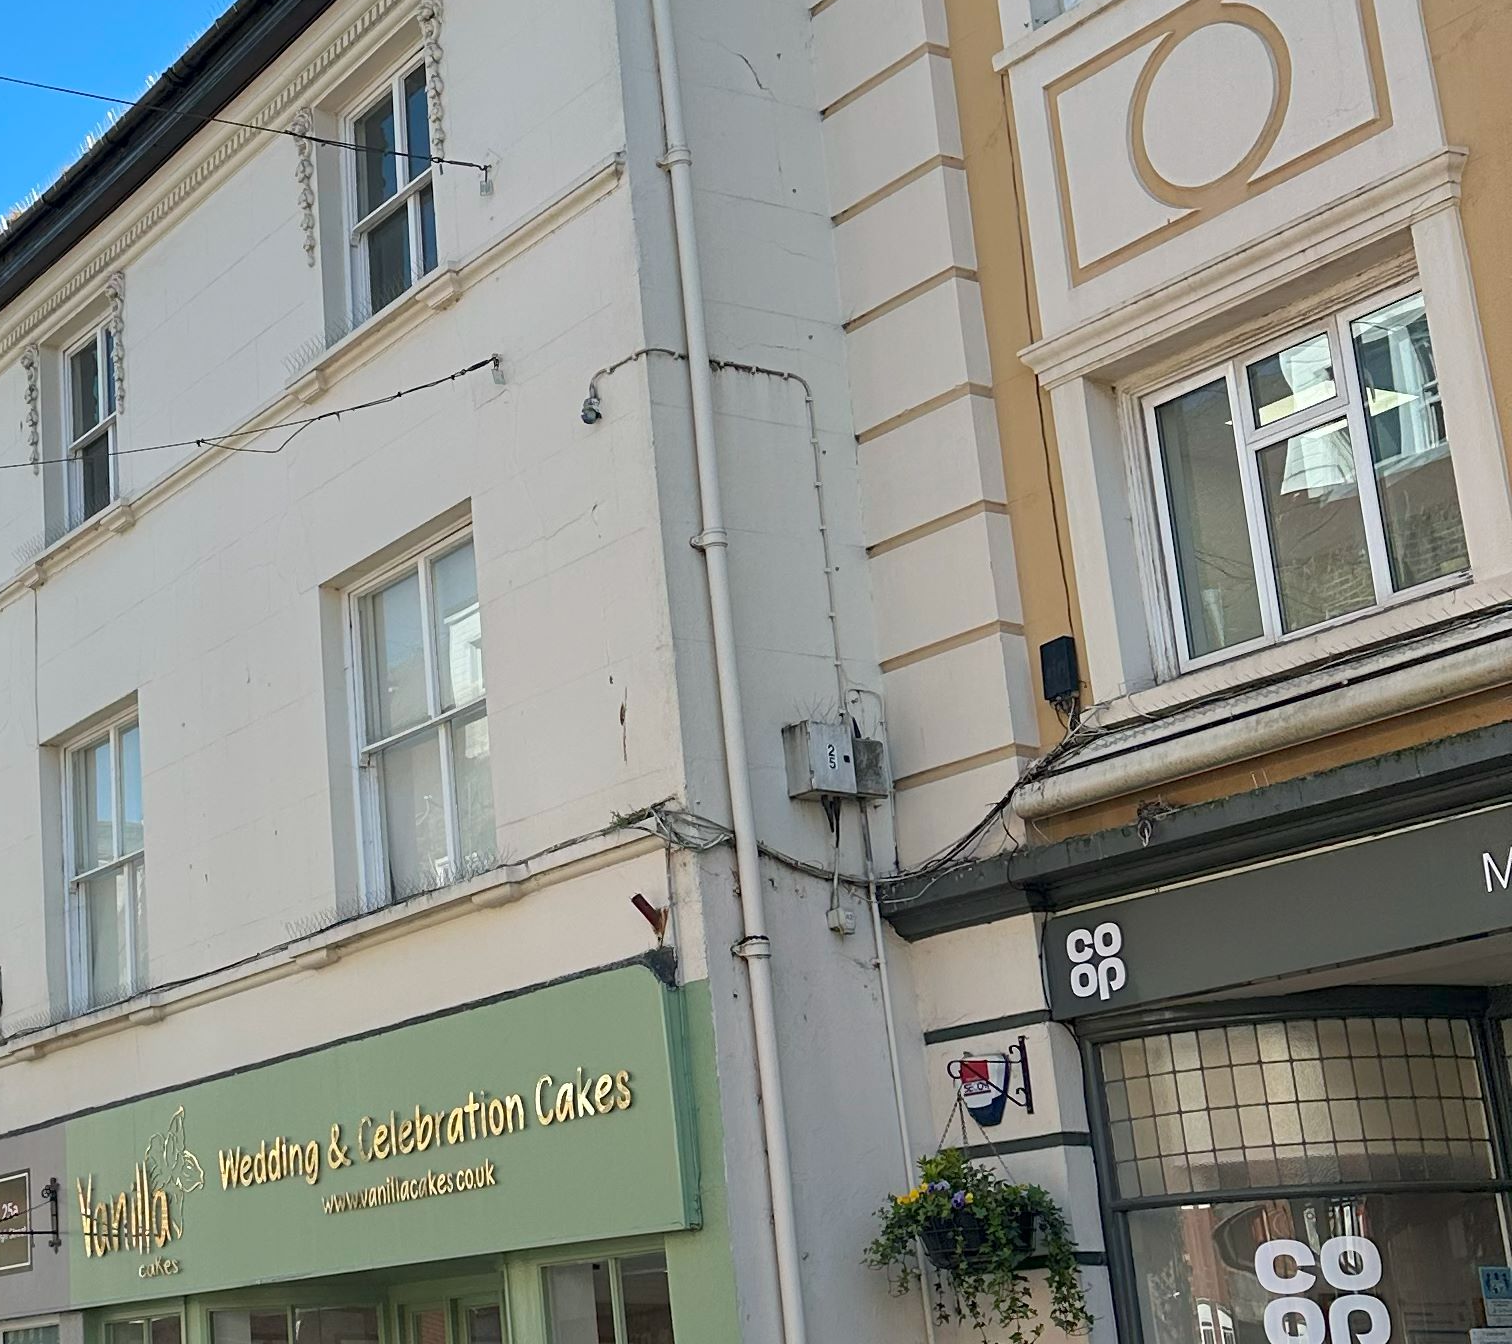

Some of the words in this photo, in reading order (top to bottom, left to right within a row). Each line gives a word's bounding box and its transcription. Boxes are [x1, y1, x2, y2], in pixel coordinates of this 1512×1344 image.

[219, 1136, 319, 1191] Wedding
[328, 1123, 353, 1169] &
[358, 1090, 524, 1162] Celebration
[535, 1066, 631, 1125] Cakes
[77, 1161, 172, 1258] Vanilla
